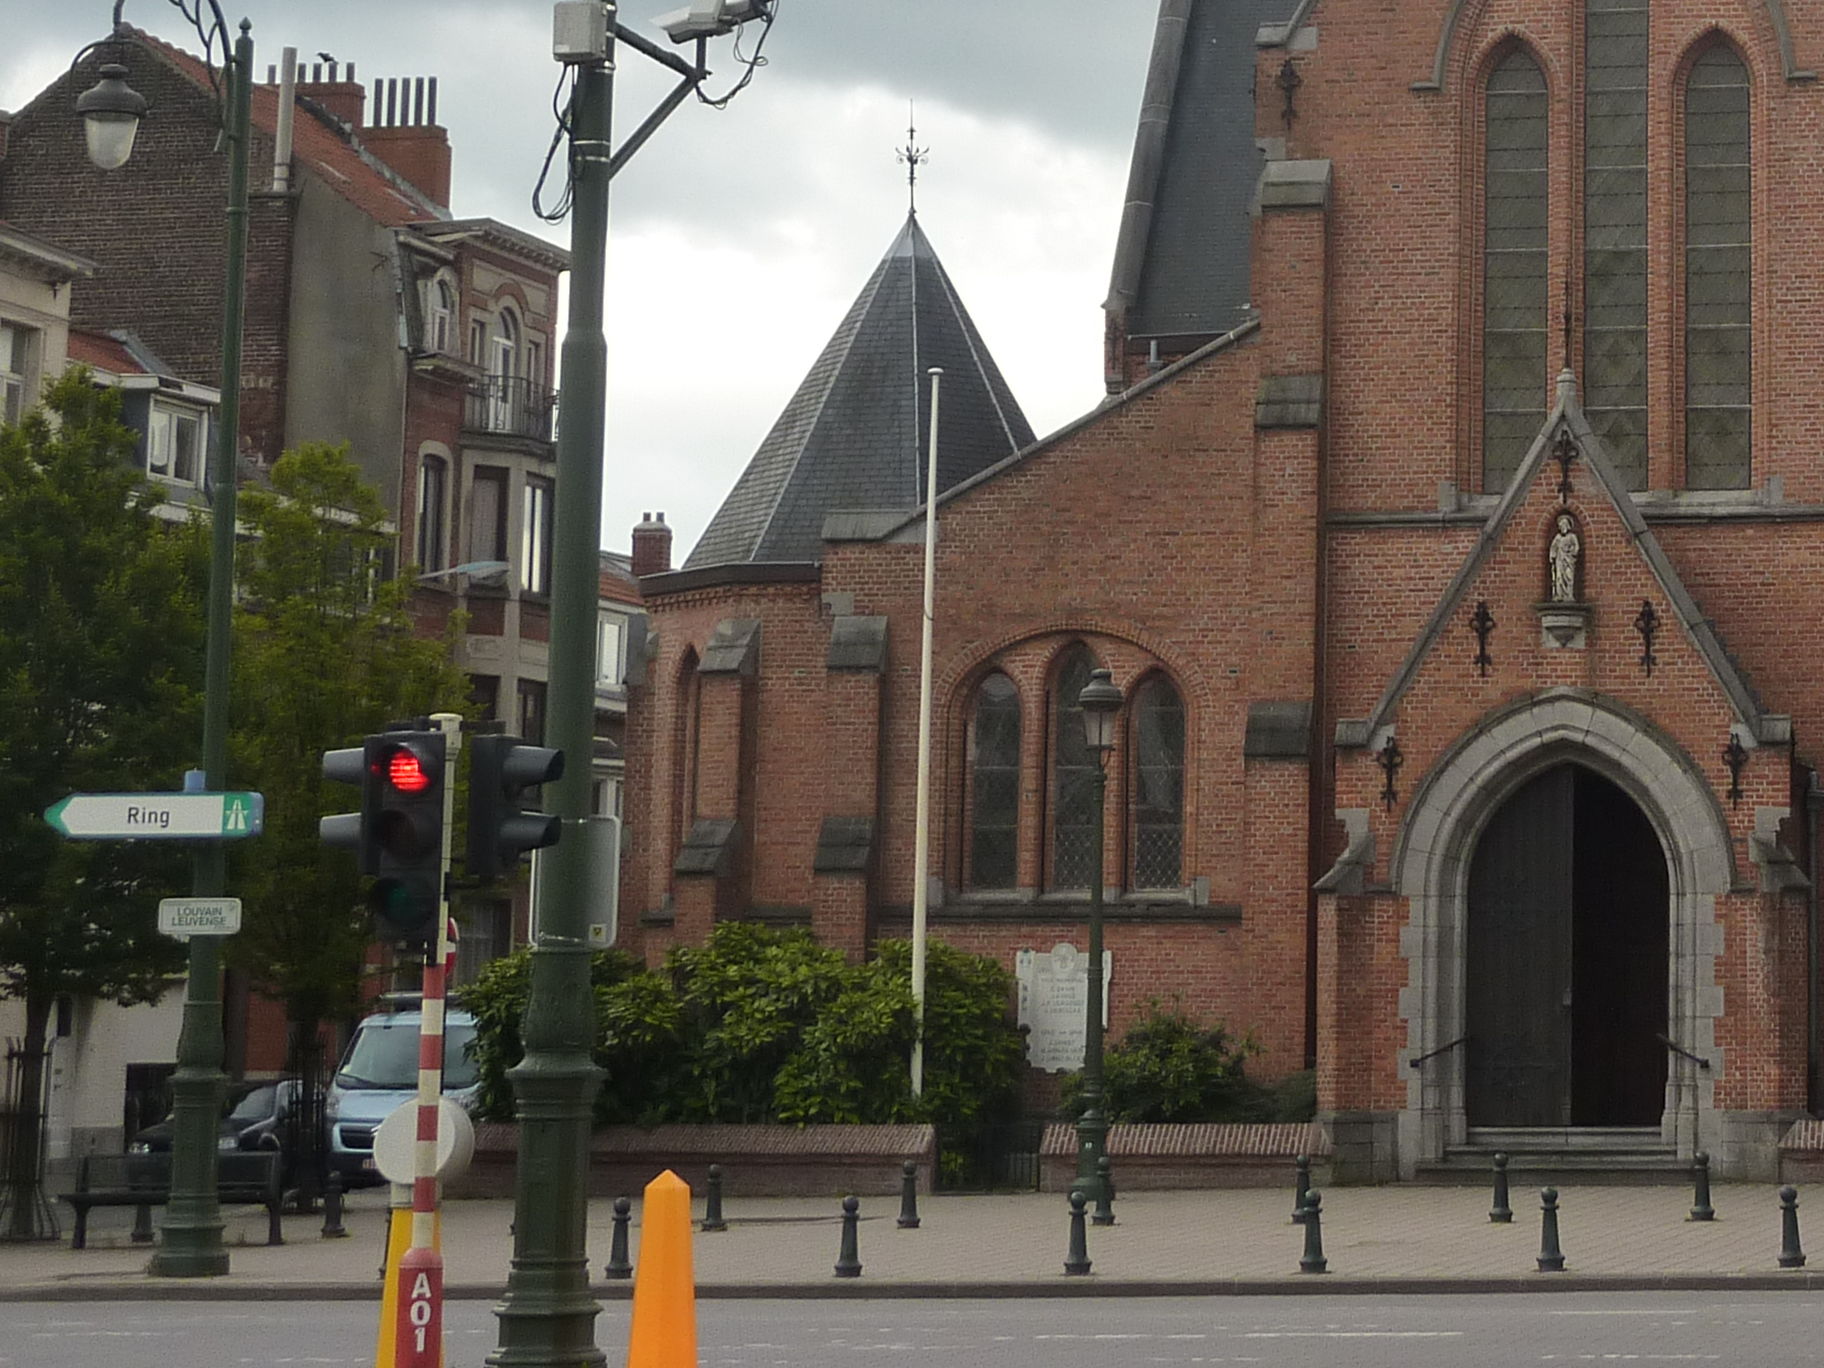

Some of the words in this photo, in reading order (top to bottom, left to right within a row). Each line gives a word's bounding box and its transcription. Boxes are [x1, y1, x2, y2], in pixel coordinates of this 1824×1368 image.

[127, 806, 171, 829] Ring
[177, 906, 223, 916] LOUVAIN
[171, 916, 227, 927] LEUVENSE
[409, 1272, 432, 1352] A01
